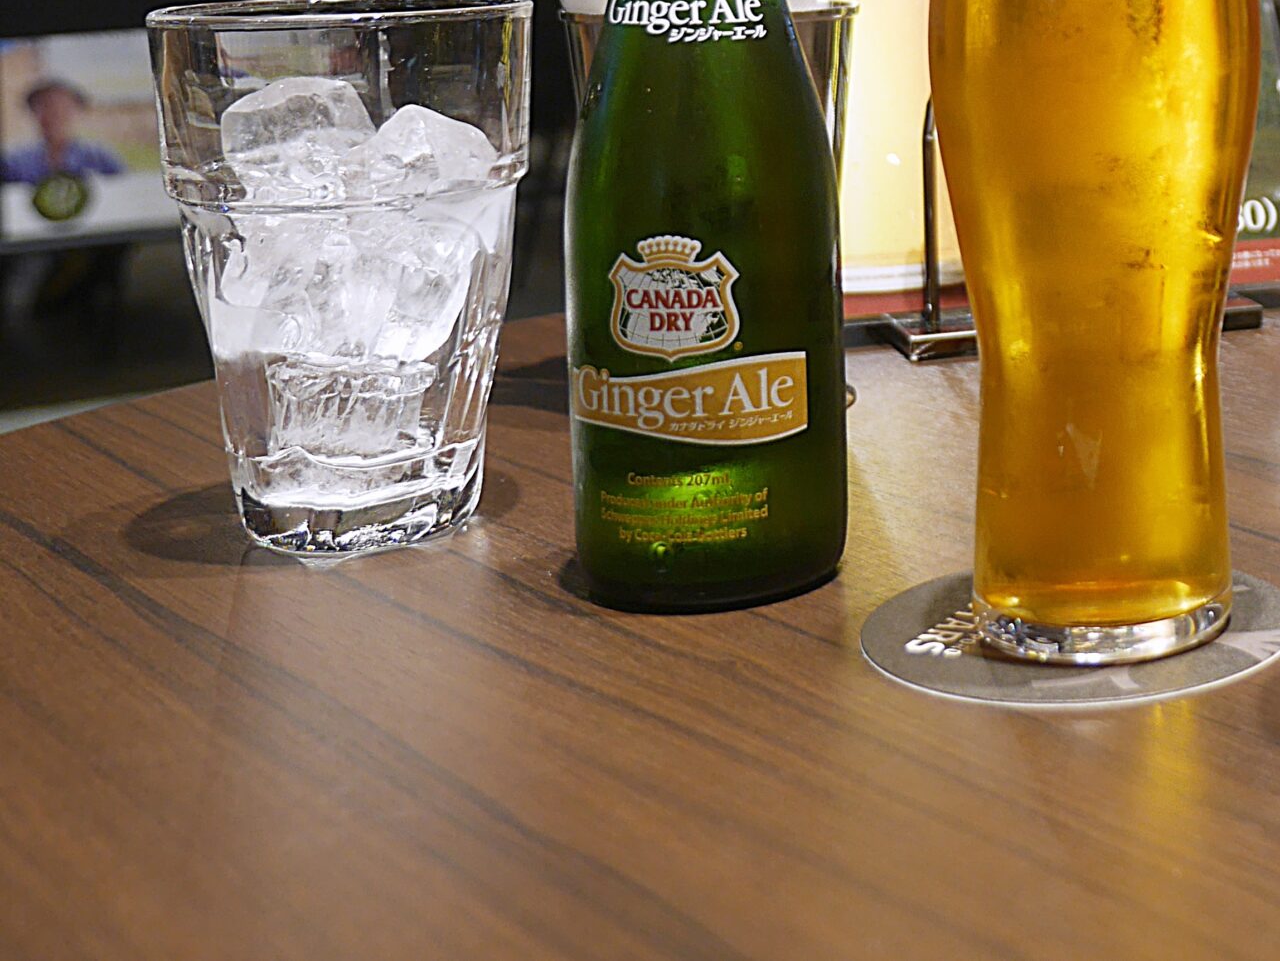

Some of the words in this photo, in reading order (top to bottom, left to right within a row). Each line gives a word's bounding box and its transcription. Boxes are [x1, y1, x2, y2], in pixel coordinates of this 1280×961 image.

[668, 24, 767, 43] ジンジャーエール
[625, 289, 722, 310] CANADA
[649, 311, 695, 332] DRY
[577, 368, 714, 430] Ginger
[719, 367, 794, 416] Ale
[754, 487, 769, 501] of
[720, 503, 769, 524] Limited
[619, 528, 633, 543] by
